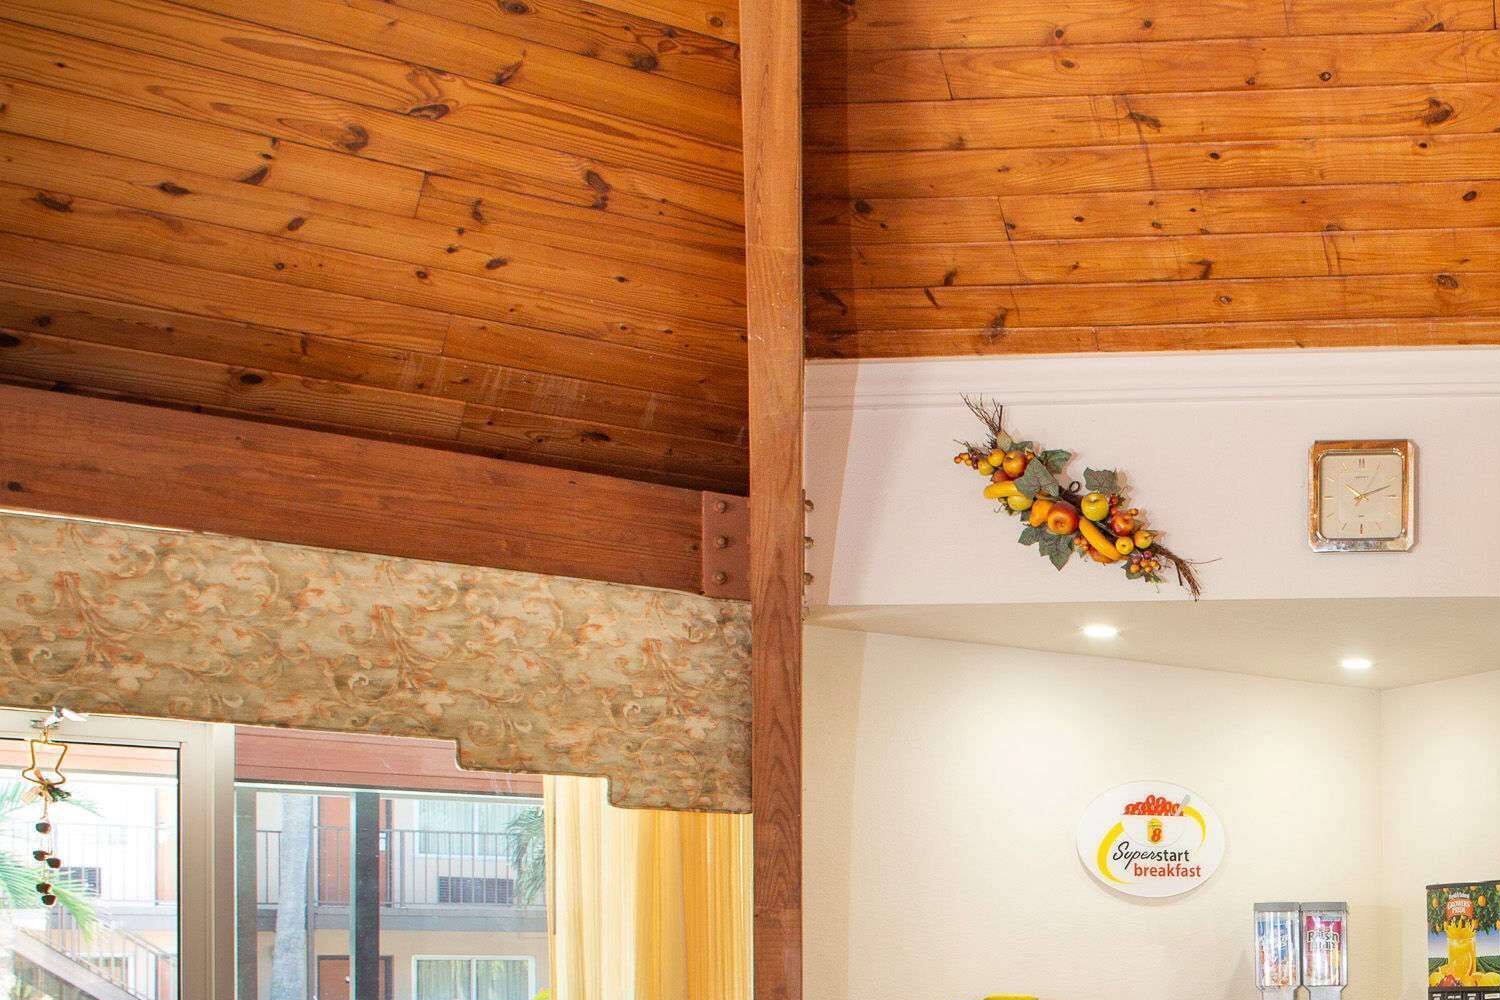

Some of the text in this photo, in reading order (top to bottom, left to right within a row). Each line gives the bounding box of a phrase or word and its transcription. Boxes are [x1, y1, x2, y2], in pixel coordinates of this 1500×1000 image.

[1151, 828, 1162, 842] 8
[1112, 841, 1190, 870] Superstart
[1133, 863, 1201, 877] breakfast
